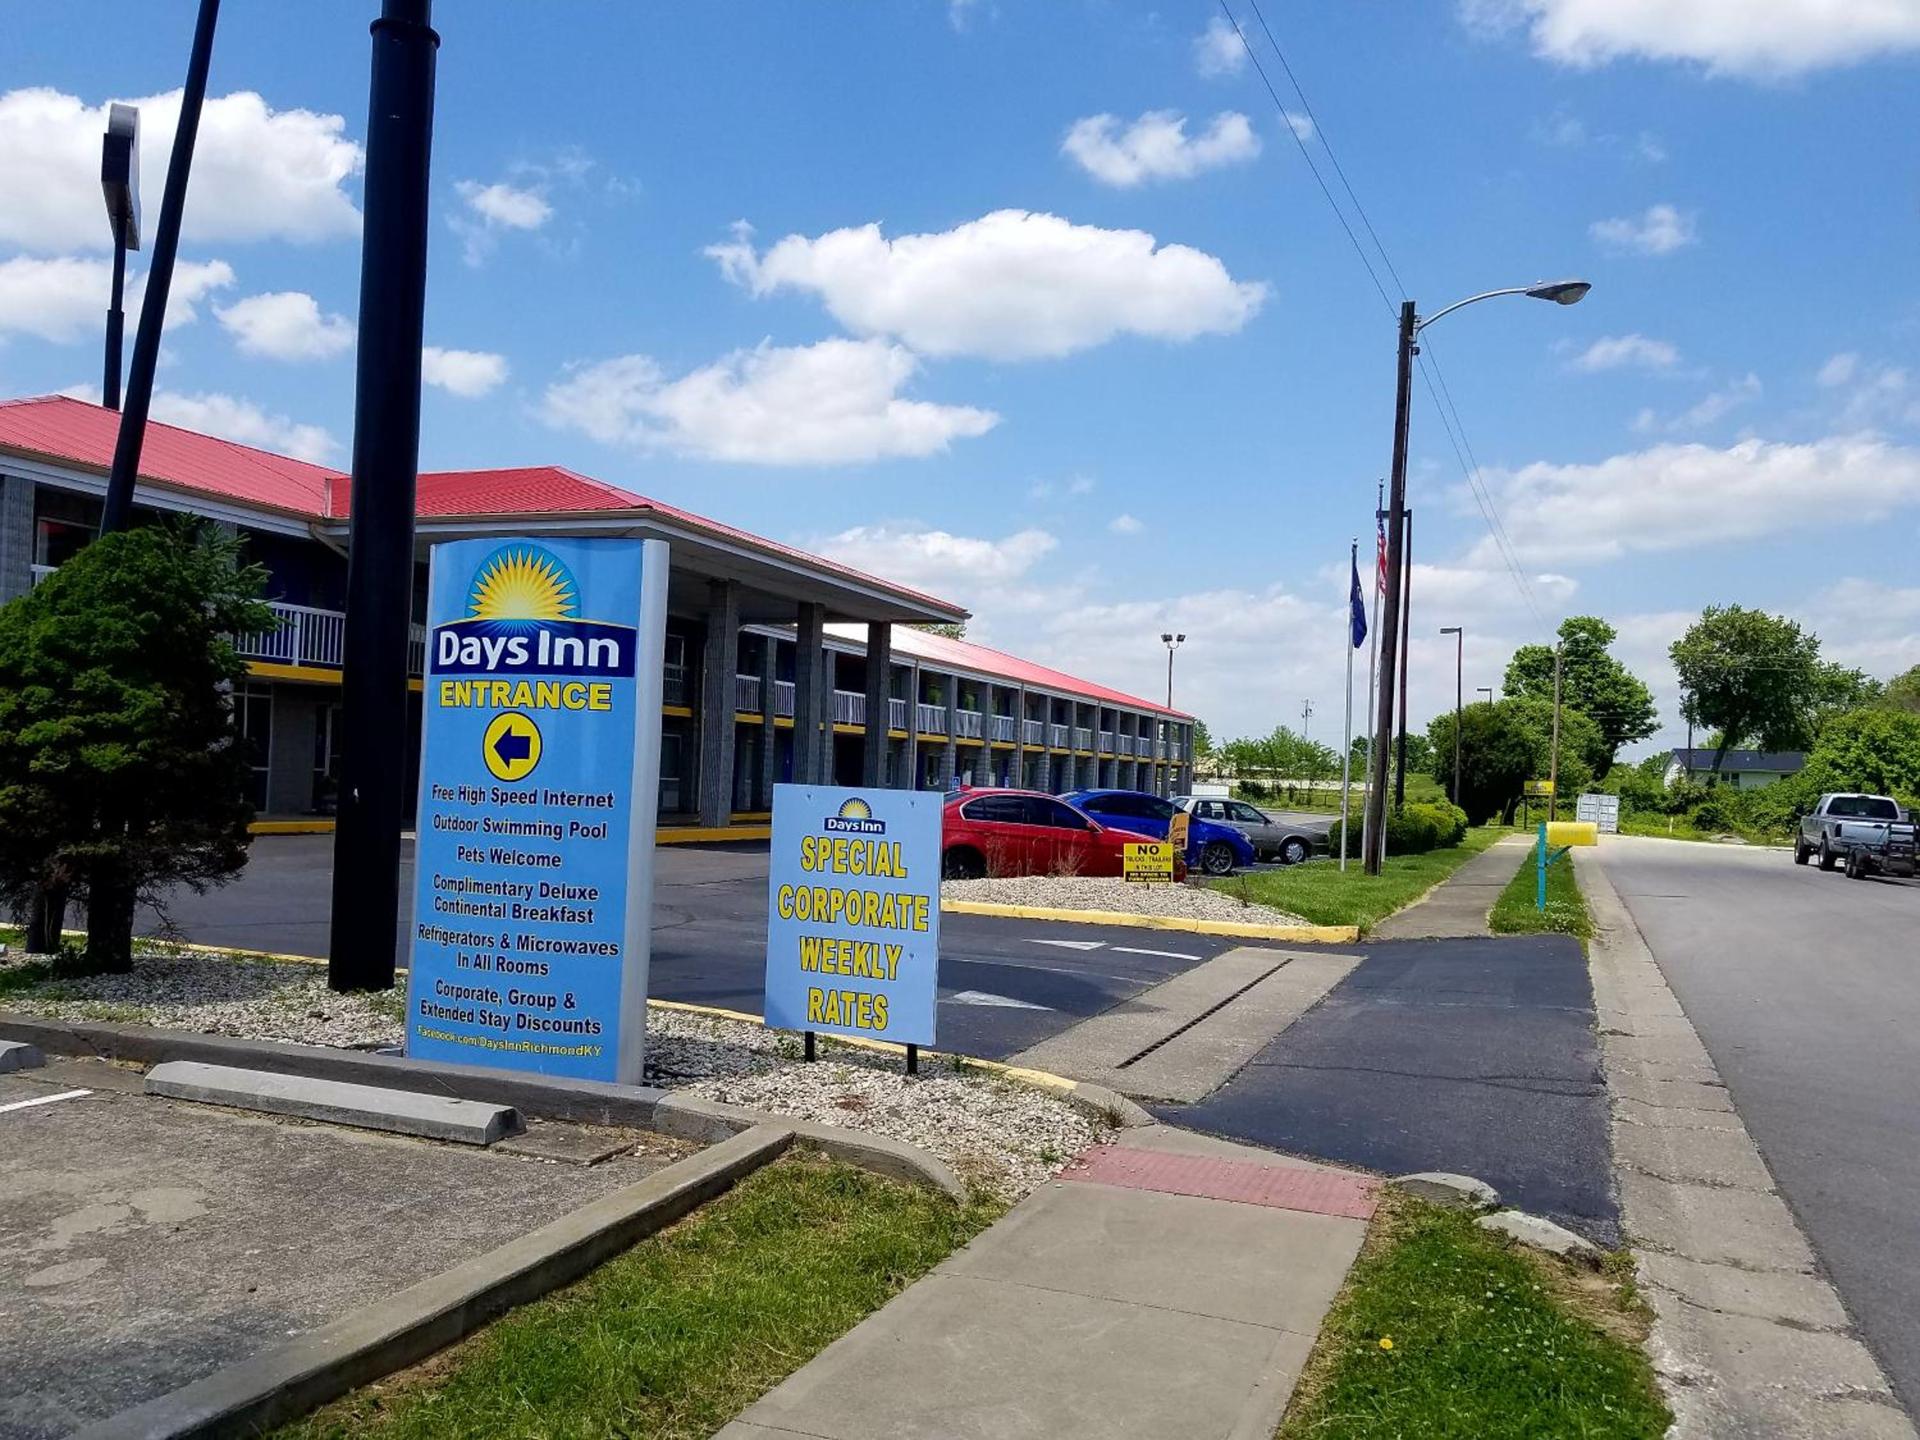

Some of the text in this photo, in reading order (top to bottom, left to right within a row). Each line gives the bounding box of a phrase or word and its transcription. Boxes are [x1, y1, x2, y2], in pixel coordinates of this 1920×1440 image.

[439, 630, 619, 670] Days Inn
[440, 681, 612, 711] ENTRANCE
[432, 784, 614, 808] Free High Speed Internet
[434, 814, 607, 840] Outdoor Swimming Pool
[828, 819, 883, 832] Days Inn
[458, 846, 562, 867] Pets Welcome
[801, 836, 908, 878] SPECIAL
[1137, 845, 1159, 855] NO
[434, 874, 598, 901] Complimentary Deluxe
[434, 896, 593, 924] Continental Breakfast
[778, 884, 930, 932] CORPORATE
[418, 924, 619, 956] Refrigerators & Microwaves
[457, 952, 549, 975] In All Rooms
[800, 936, 903, 980] WEEKLY
[436, 979, 576, 1011] Corporate, Group &
[808, 988, 889, 1031] RATES
[421, 1000, 601, 1035] Extended Stay Discounts
